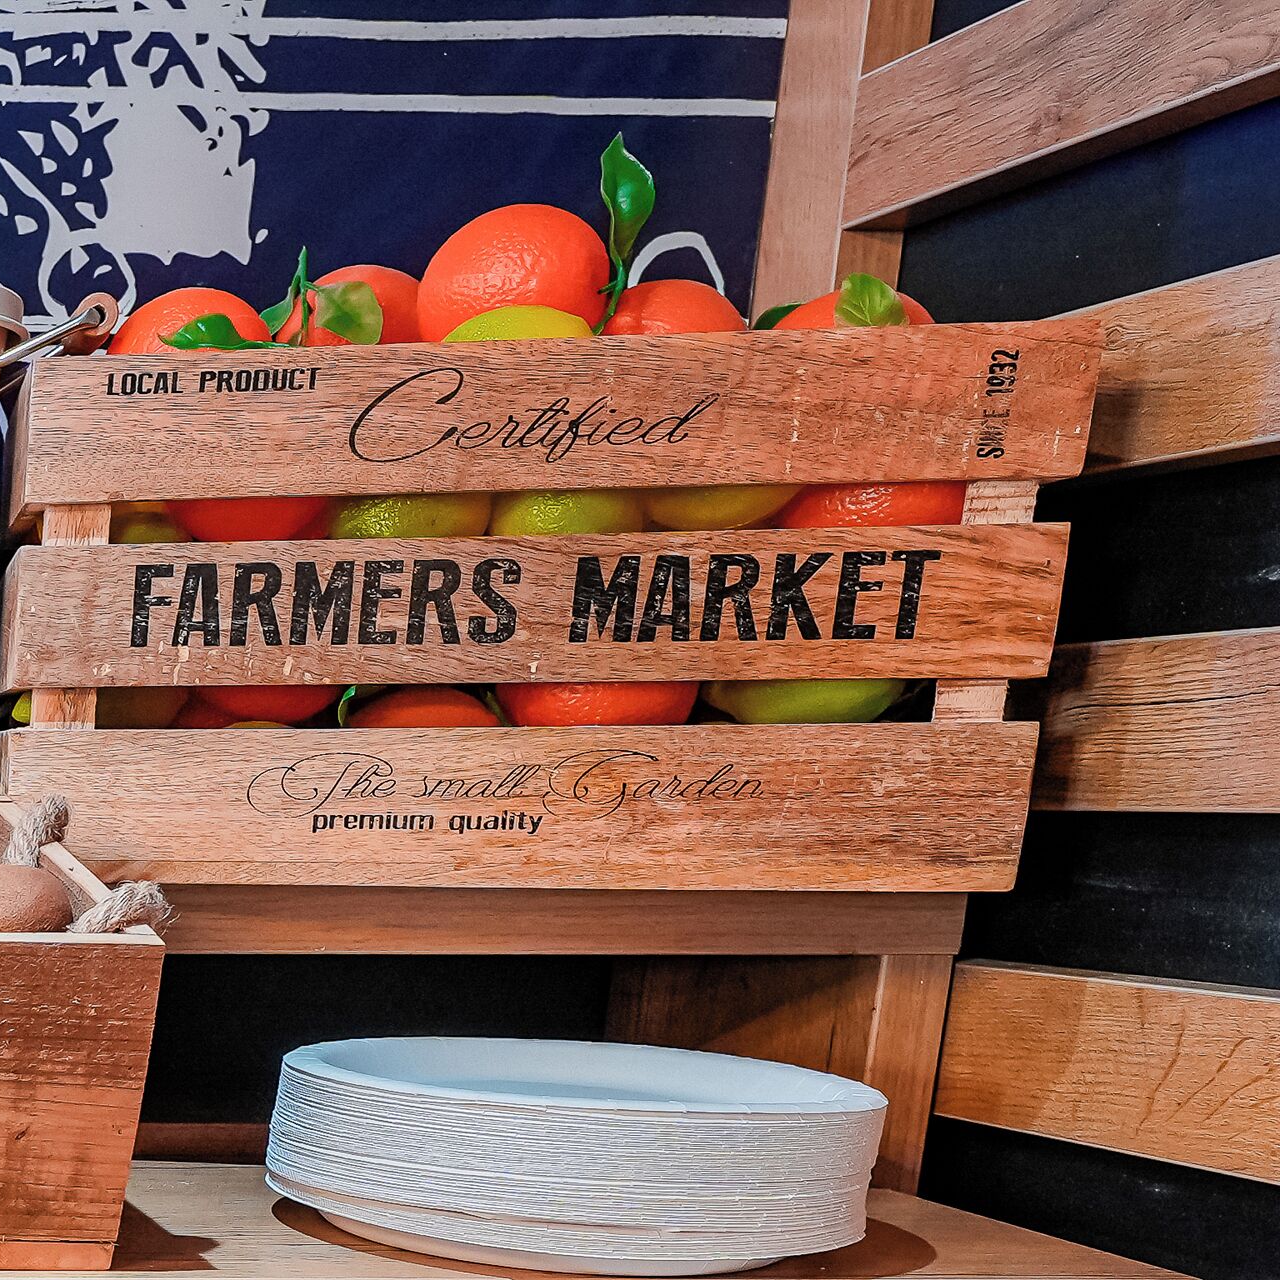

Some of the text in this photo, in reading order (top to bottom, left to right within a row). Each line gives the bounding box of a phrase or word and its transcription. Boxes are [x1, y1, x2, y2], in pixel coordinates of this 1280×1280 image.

[106, 367, 321, 397] LOCAL PRODUCT
[985, 349, 1020, 397] 1932
[348, 367, 721, 465] Certified
[129, 549, 942, 648] FARMERS MARKET
[246, 748, 767, 820] The small Garden
[311, 811, 543, 835] premium quality
